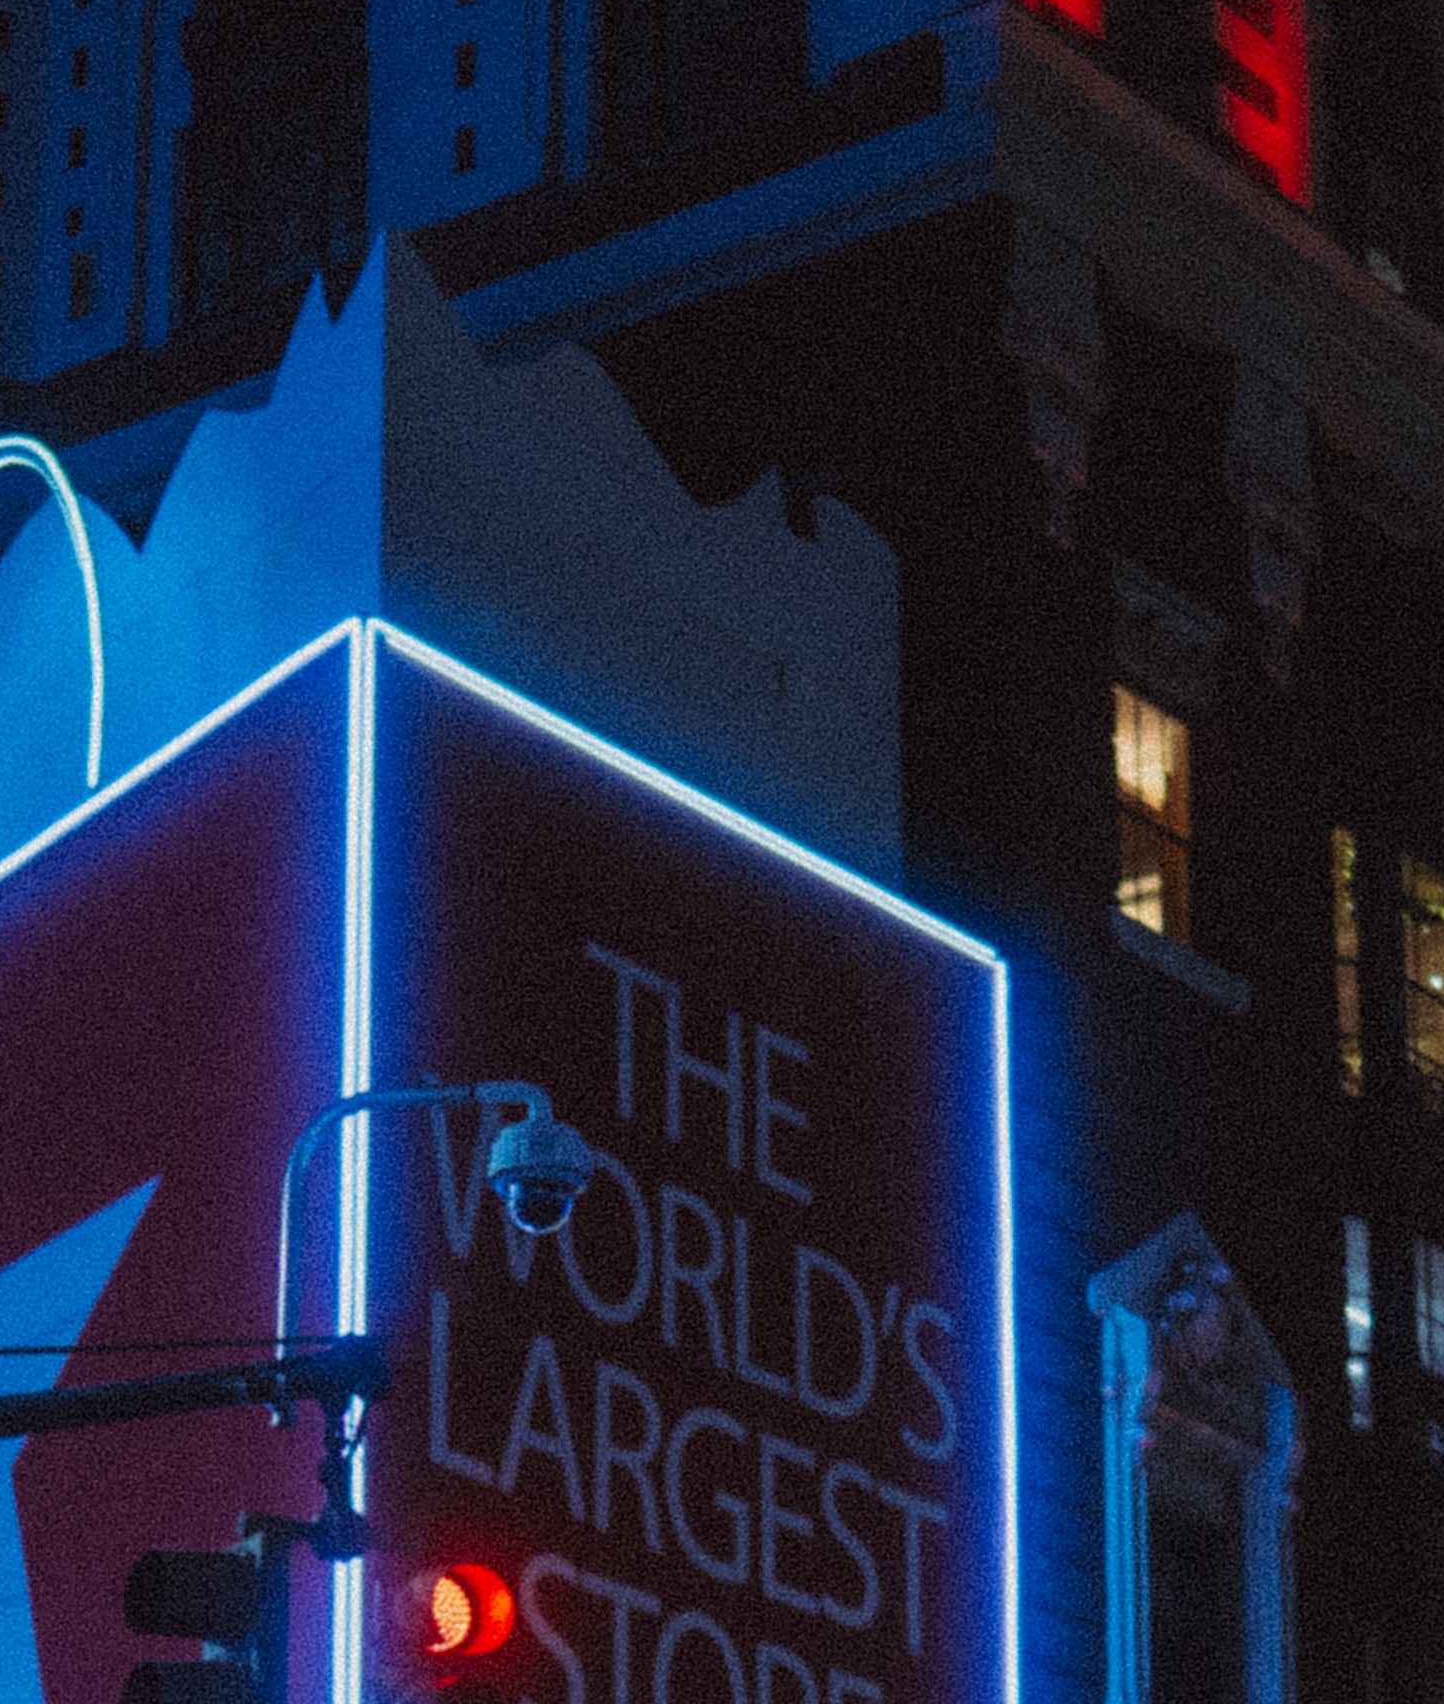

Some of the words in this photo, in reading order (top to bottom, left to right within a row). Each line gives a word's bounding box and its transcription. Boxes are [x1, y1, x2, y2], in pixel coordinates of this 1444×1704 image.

[586, 942, 813, 1203] THE
[426, 1074, 955, 1463] WORLD'S
[429, 1291, 951, 1655] LARGEST
